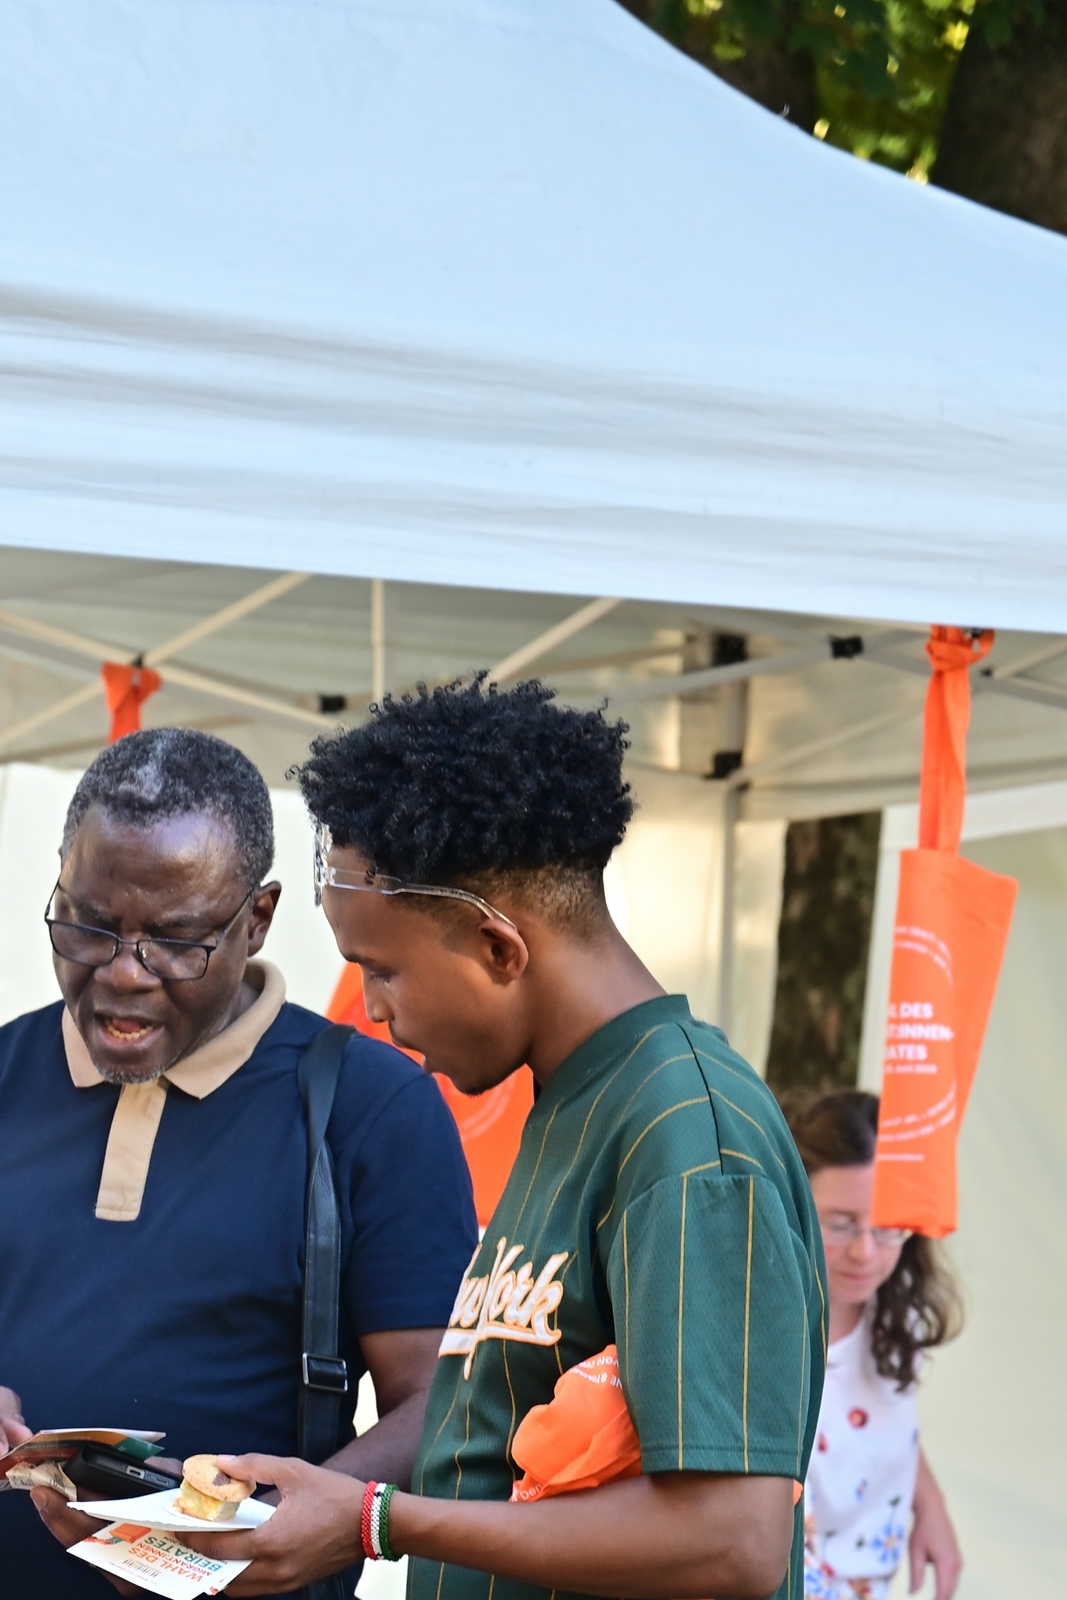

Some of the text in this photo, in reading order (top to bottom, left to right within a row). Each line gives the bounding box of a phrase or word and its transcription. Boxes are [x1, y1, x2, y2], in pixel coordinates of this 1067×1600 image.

[899, 1002, 934, 1019] DES
[128, 1547, 157, 1564] DES
[144, 1536, 222, 1573] BEIRATES
[160, 1559, 204, 1583] WAHL
